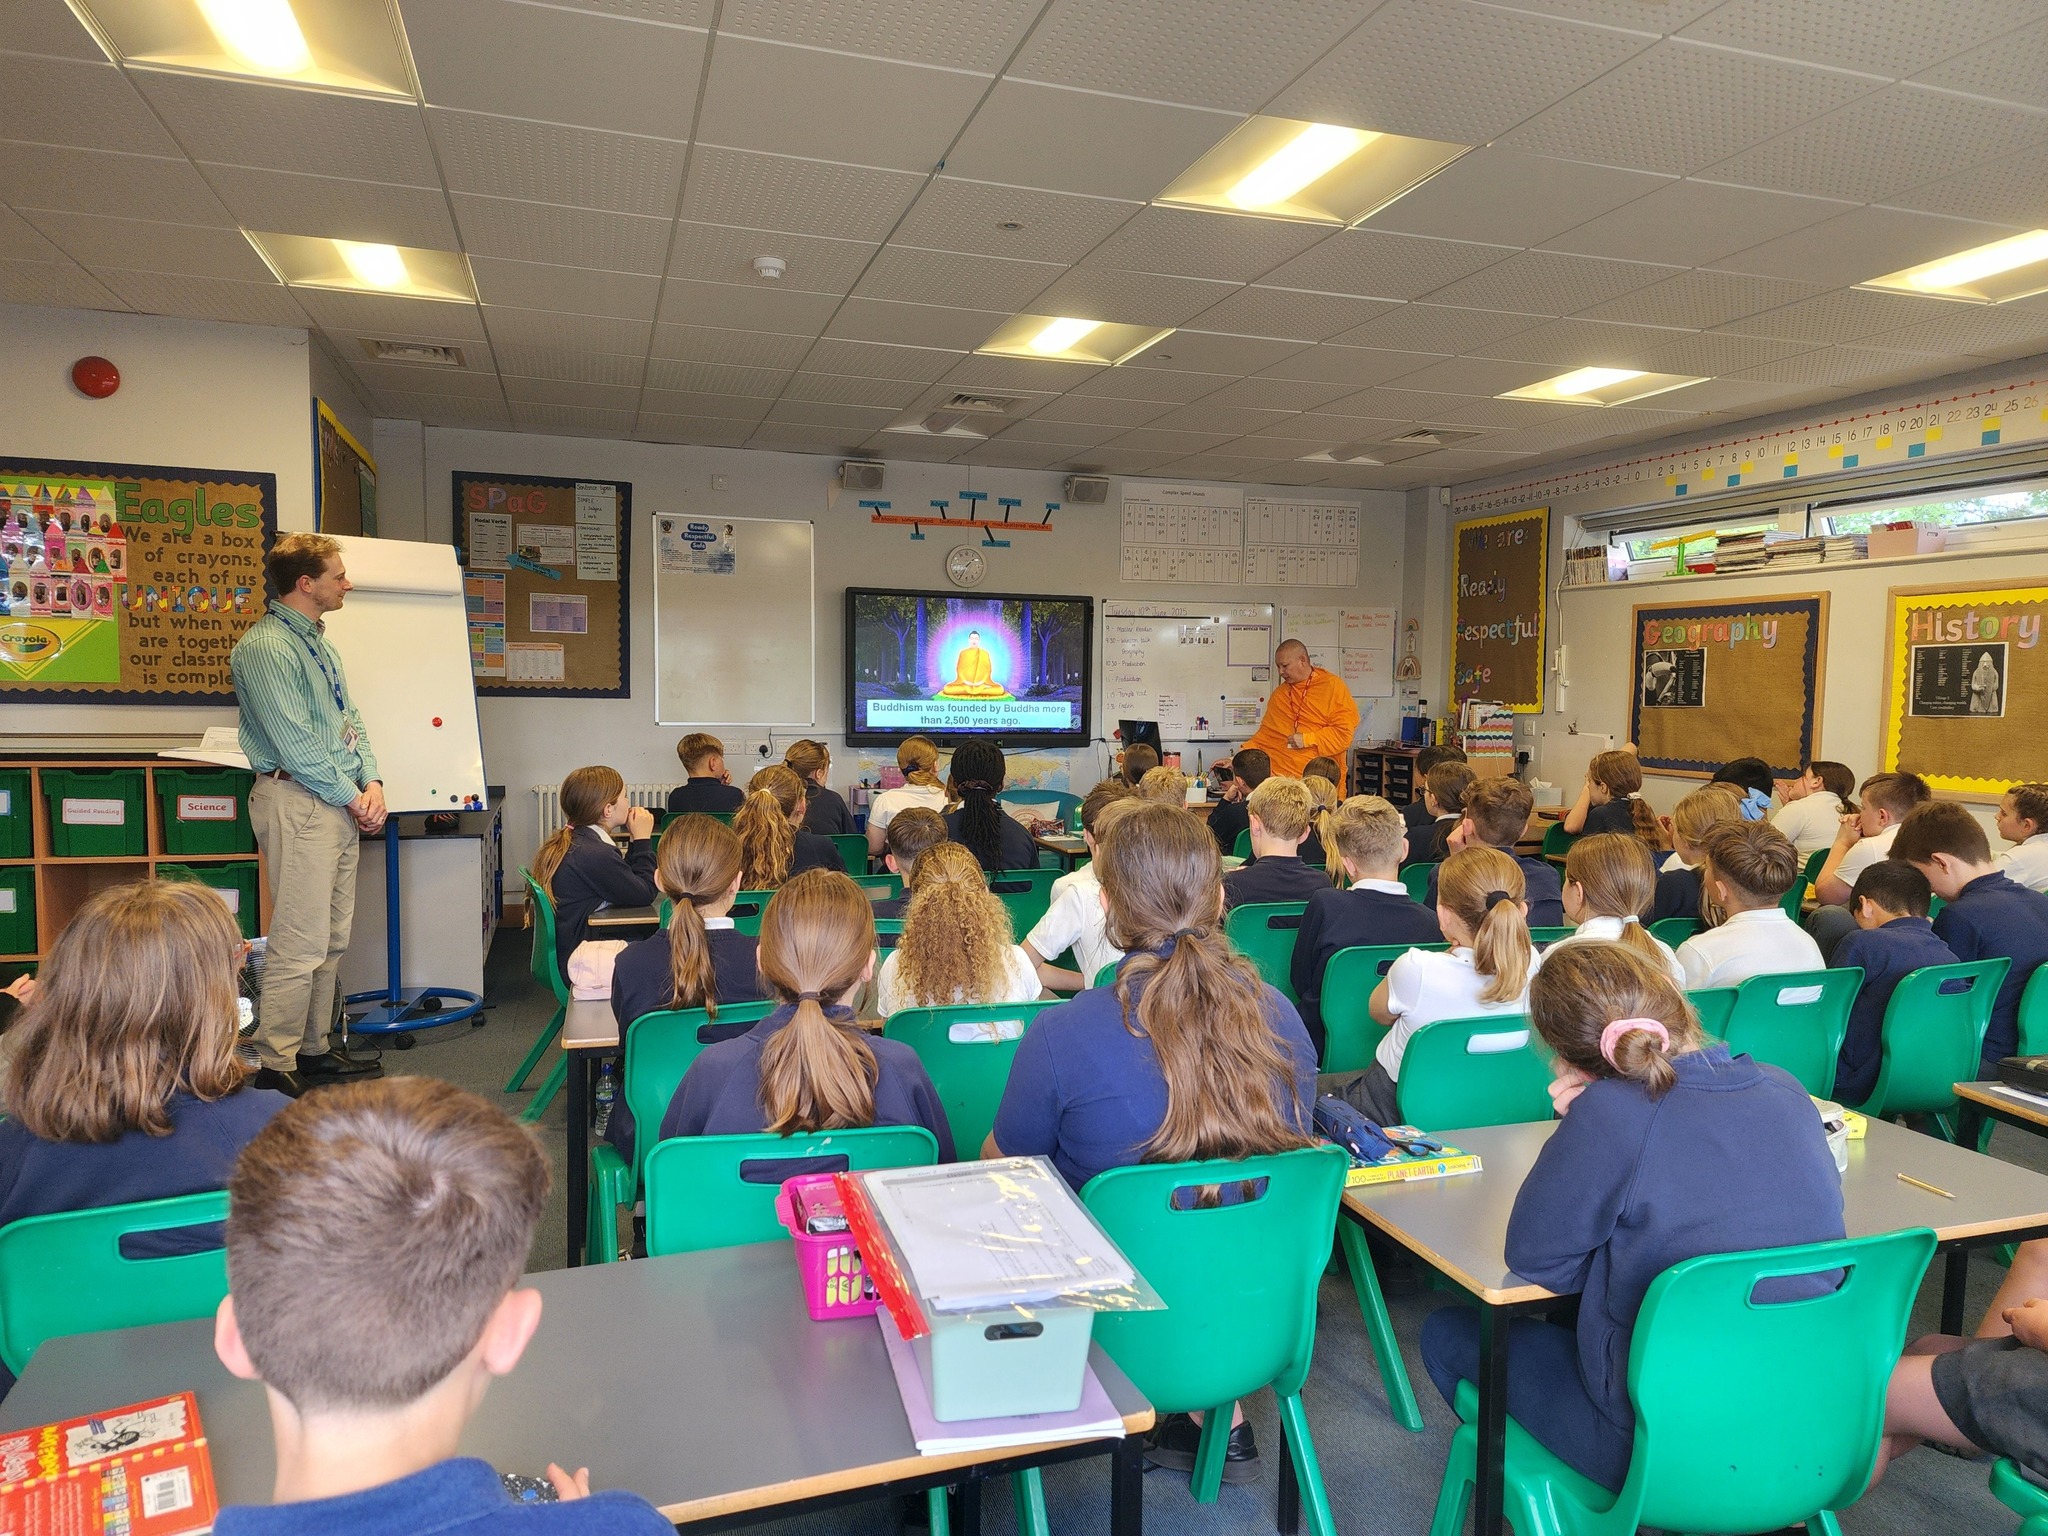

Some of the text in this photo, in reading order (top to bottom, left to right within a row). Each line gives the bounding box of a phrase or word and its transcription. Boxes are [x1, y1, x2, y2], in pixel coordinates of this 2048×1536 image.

[1612, 474, 1620, 484] -2
[1624, 472, 1630, 482] -1
[1635, 470, 1640, 480] 0
[1658, 466, 1664, 477] 2
[1669, 464, 1675, 474] 3
[1682, 462, 1686, 472] 4
[1694, 460, 1699, 470] 5
[1706, 458, 1712, 468] 6
[1719, 455, 1724, 466] 7
[1732, 452, 1738, 463] 8
[1744, 450, 1750, 460] 9
[1757, 447, 1765, 458] 10
[1773, 445, 1780, 455] 11
[1787, 441, 1796, 452] 12
[1802, 438, 1810, 450] 13
[1816, 436, 1826, 447] 14
[1832, 432, 1842, 444] 15
[1847, 430, 1857, 441] 16
[1862, 426, 1872, 438] 17
[1879, 424, 1890, 436] 18
[1896, 420, 1907, 432] 19
[1910, 416, 1924, 430] 20
[1930, 414, 1940, 426] 21
[1946, 410, 1962, 423] 22
[1966, 406, 1980, 420] 23
[1984, 402, 1998, 416] 24
[2004, 399, 2020, 412] 25
[2024, 394, 2039, 410] 26
[468, 485, 548, 514] SPaG
[115, 482, 260, 536] Eagles
[123, 525, 256, 549] We are a box
[144, 547, 258, 569] of crayons,
[153, 568, 258, 587] each of us
[129, 613, 161, 629] but
[169, 614, 222, 630] when
[1911, 610, 2041, 649] History
[2, 634, 47, 643] Crayola
[1645, 612, 1778, 650] Geography
[139, 636, 168, 649] are
[129, 653, 162, 667] our
[143, 670, 158, 685] is
[1456, 663, 1492, 694] Safe
[872, 702, 923, 712] Buddhism
[947, 703, 987, 713] founded
[989, 704, 1001, 715] by
[1003, 704, 1040, 713] Buddha
[920, 715, 1021, 727] than 2,500 years ago.
[187, 803, 227, 811] Science
[1351, 1175, 1366, 1184] 100
[1387, 1169, 1410, 1180] PLANET
[1411, 1166, 1434, 1177] EARTH
